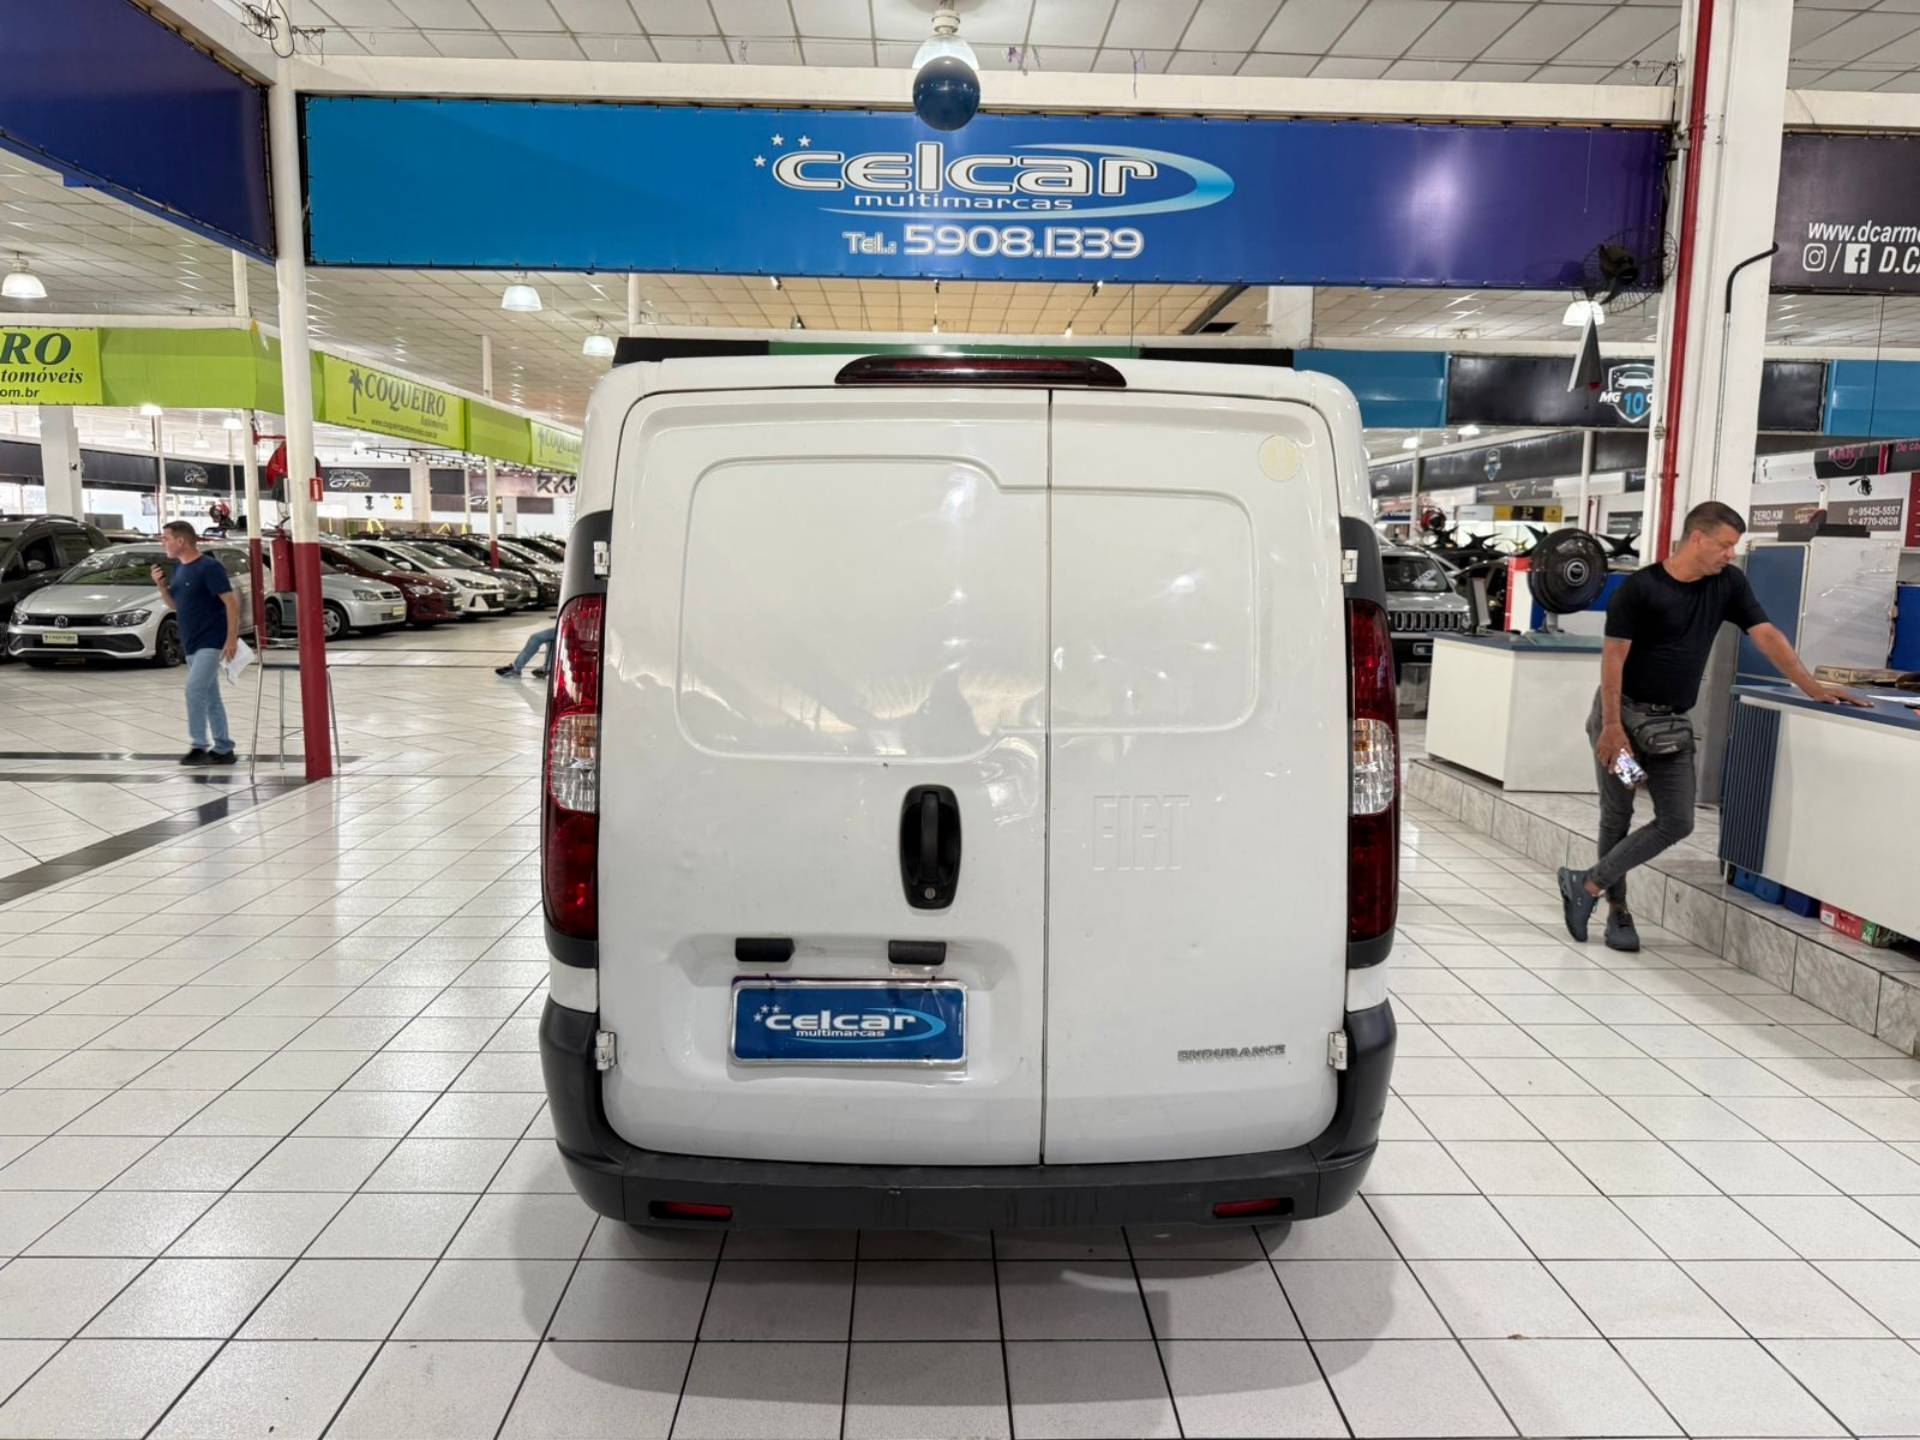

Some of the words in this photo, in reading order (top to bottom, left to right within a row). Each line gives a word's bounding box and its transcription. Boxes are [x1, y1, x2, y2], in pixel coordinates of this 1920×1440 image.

[773, 141, 1157, 197] celcar
[854, 193, 1073, 210] multimarcas
[903, 223, 1145, 259] 5908.1339
[1878, 246, 1920, 274] D.C
[364, 373, 446, 418] COQUEIRO
[1599, 391, 1621, 403] MG
[1624, 391, 1645, 415] 10
[1092, 794, 1190, 871] FIAT
[765, 1010, 916, 1031] celcar
[796, 1028, 885, 1038] multimarcas
